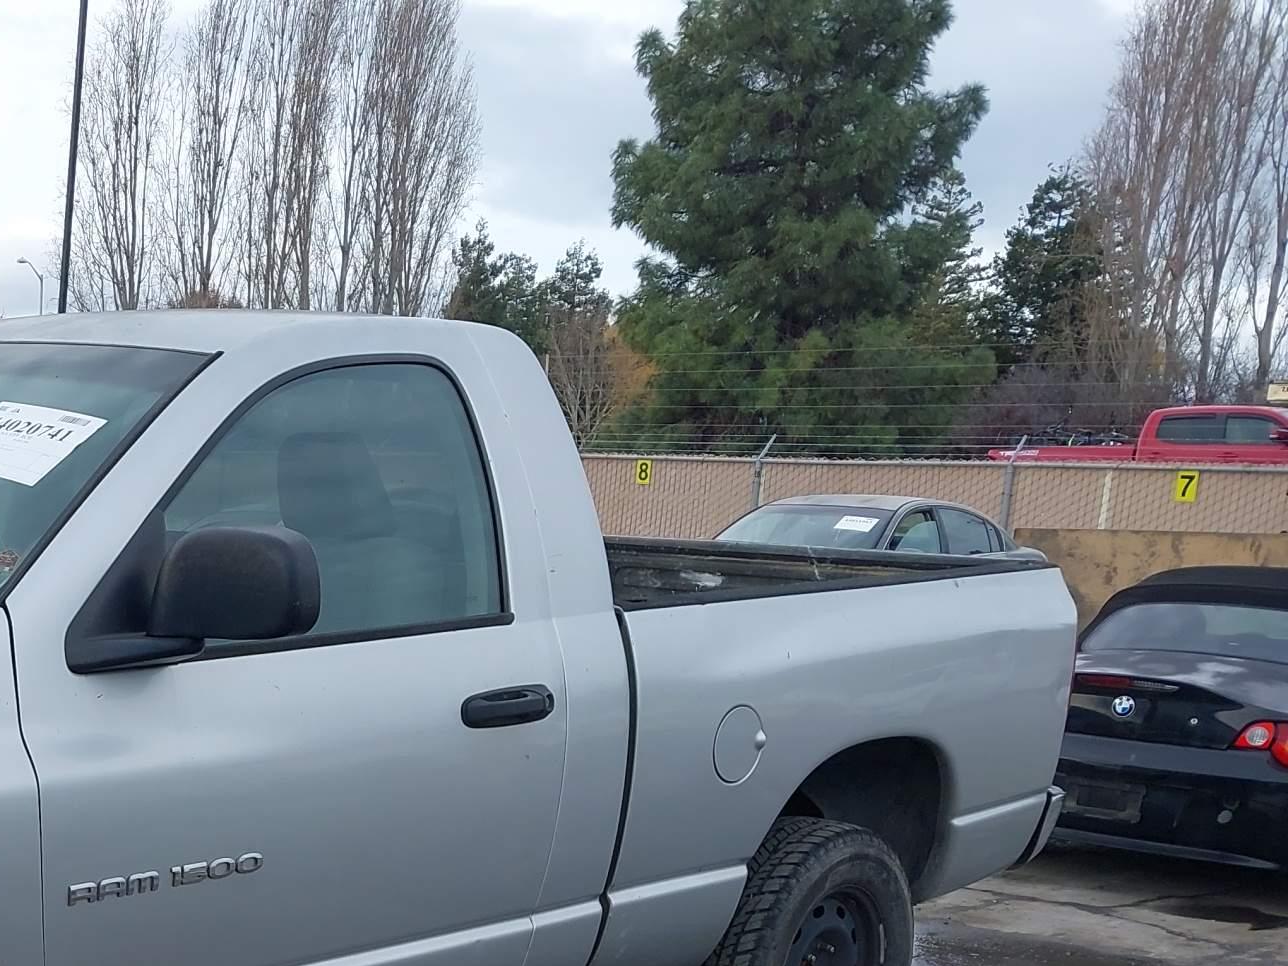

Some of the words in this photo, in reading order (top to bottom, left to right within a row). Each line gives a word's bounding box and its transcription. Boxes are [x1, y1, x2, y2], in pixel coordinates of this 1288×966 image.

[638, 462, 649, 481] 8
[1180, 474, 1196, 497] 7
[67, 870, 160, 907] RAM
[170, 852, 264, 888] 1500
